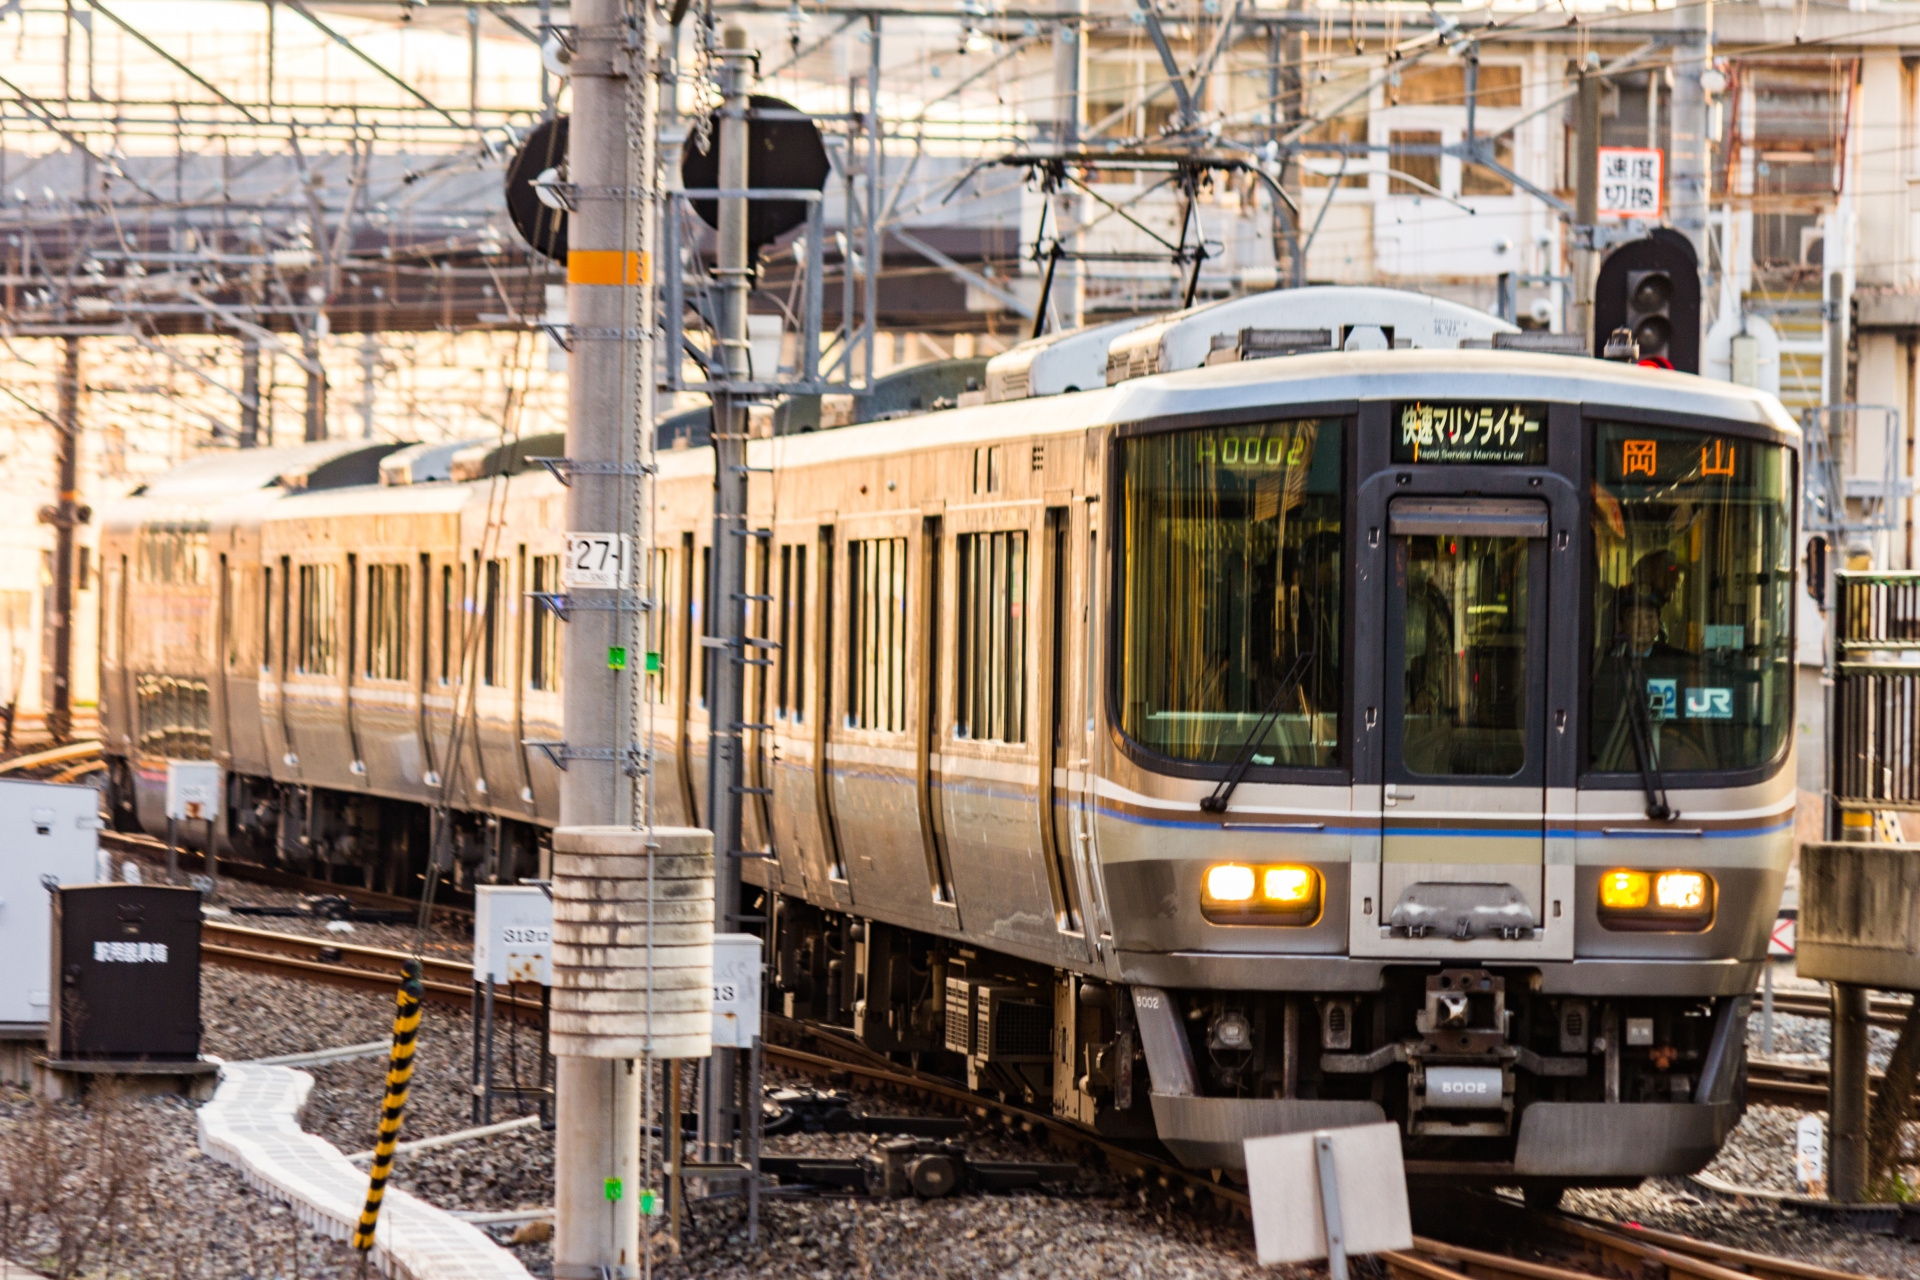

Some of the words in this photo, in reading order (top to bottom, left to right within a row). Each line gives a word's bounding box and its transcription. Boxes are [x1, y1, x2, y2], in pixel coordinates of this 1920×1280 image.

[1604, 155, 1653, 182] 速度
[1402, 404, 1540, 446] 快速マリンライナー
[1441, 449, 1472, 461] Service
[1473, 449, 1502, 460] Marine
[1503, 449, 1524, 460] Liner
[1687, 687, 1730, 712] JR
[1136, 995, 1159, 1010] 5002
[1442, 1081, 1487, 1094] 5002
